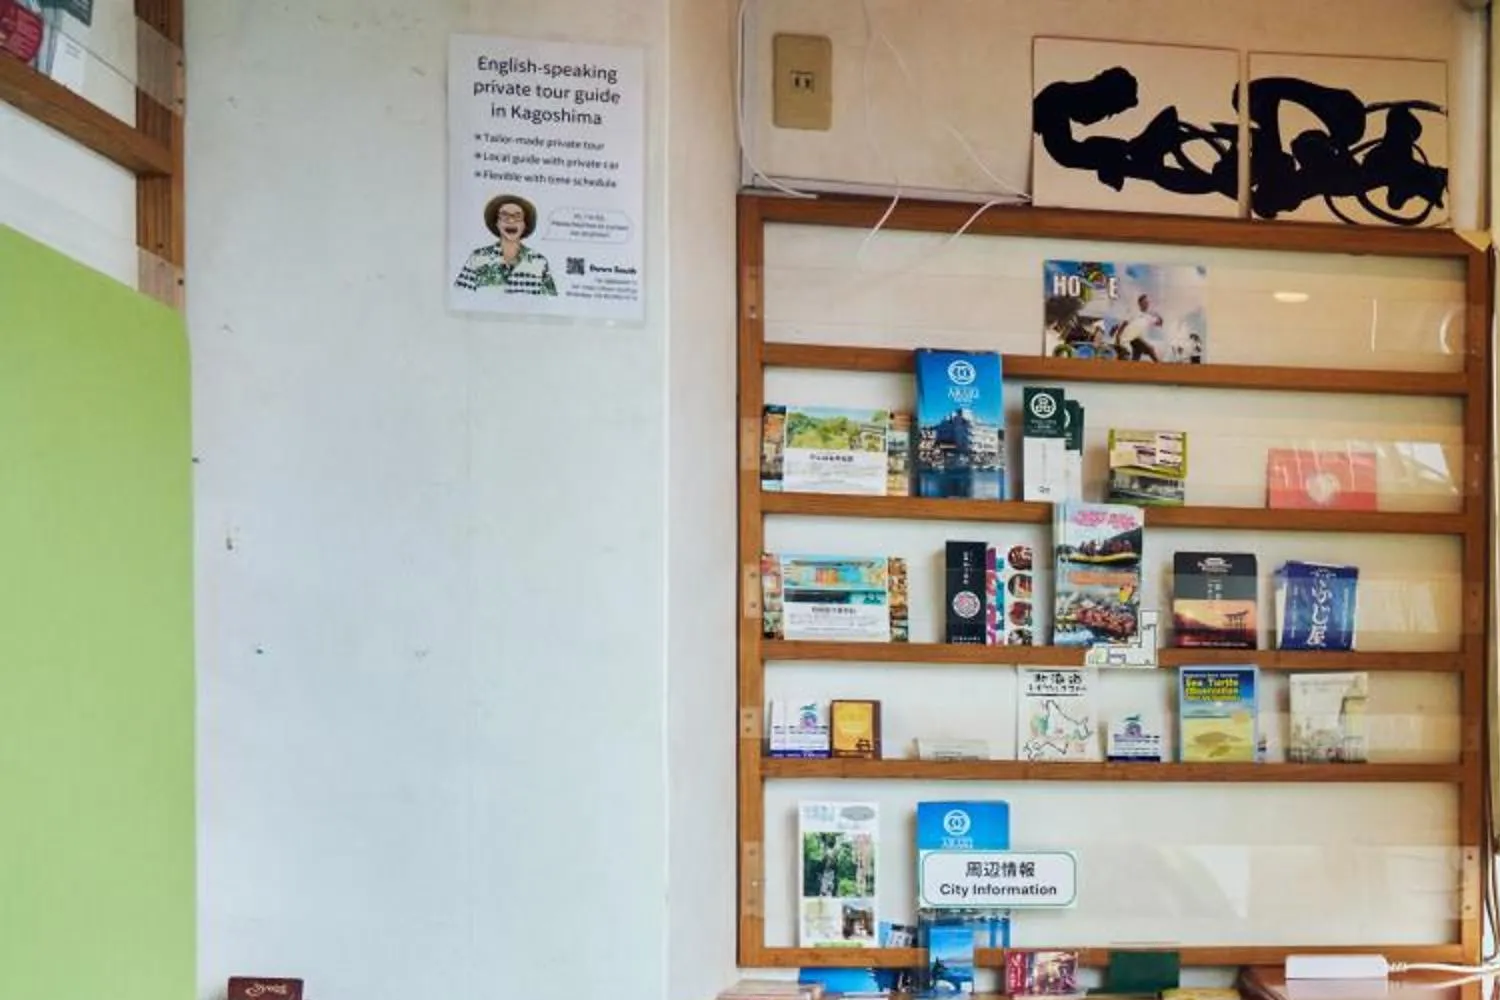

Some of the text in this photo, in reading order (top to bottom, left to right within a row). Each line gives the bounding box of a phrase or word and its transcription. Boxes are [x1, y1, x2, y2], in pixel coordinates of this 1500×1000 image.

[477, 55, 618, 84] English-speaking
[473, 80, 621, 104] private tour guide
[490, 102, 603, 125] in Kagoshima
[964, 861, 1035, 878] 周辺情報
[939, 883, 1057, 897] City Information
